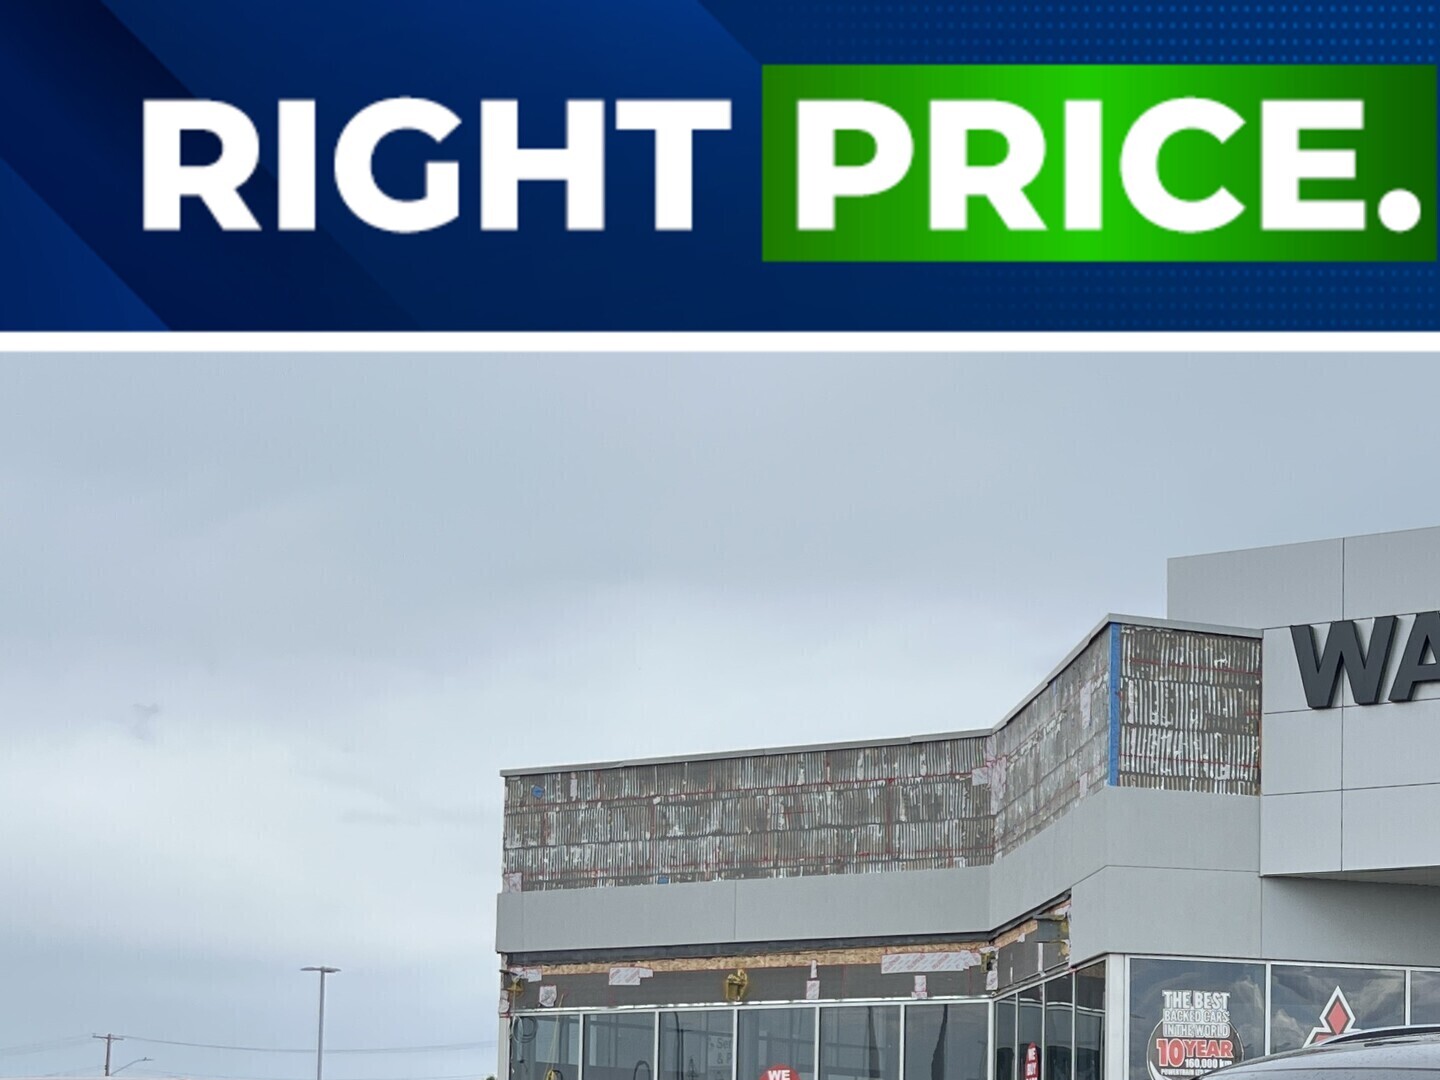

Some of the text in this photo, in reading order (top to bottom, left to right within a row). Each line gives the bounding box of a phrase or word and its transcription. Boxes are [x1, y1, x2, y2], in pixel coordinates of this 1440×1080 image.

[1163, 990, 1230, 1010] THE BEST
[1163, 1009, 1230, 1022] BACKED CARS
[1163, 1023, 1230, 1038] IN THE WORLD
[1156, 1038, 1234, 1067] 10 YEAR
[1185, 1058, 1218, 1069] 160,000
[768, 1069, 791, 1080] WE
